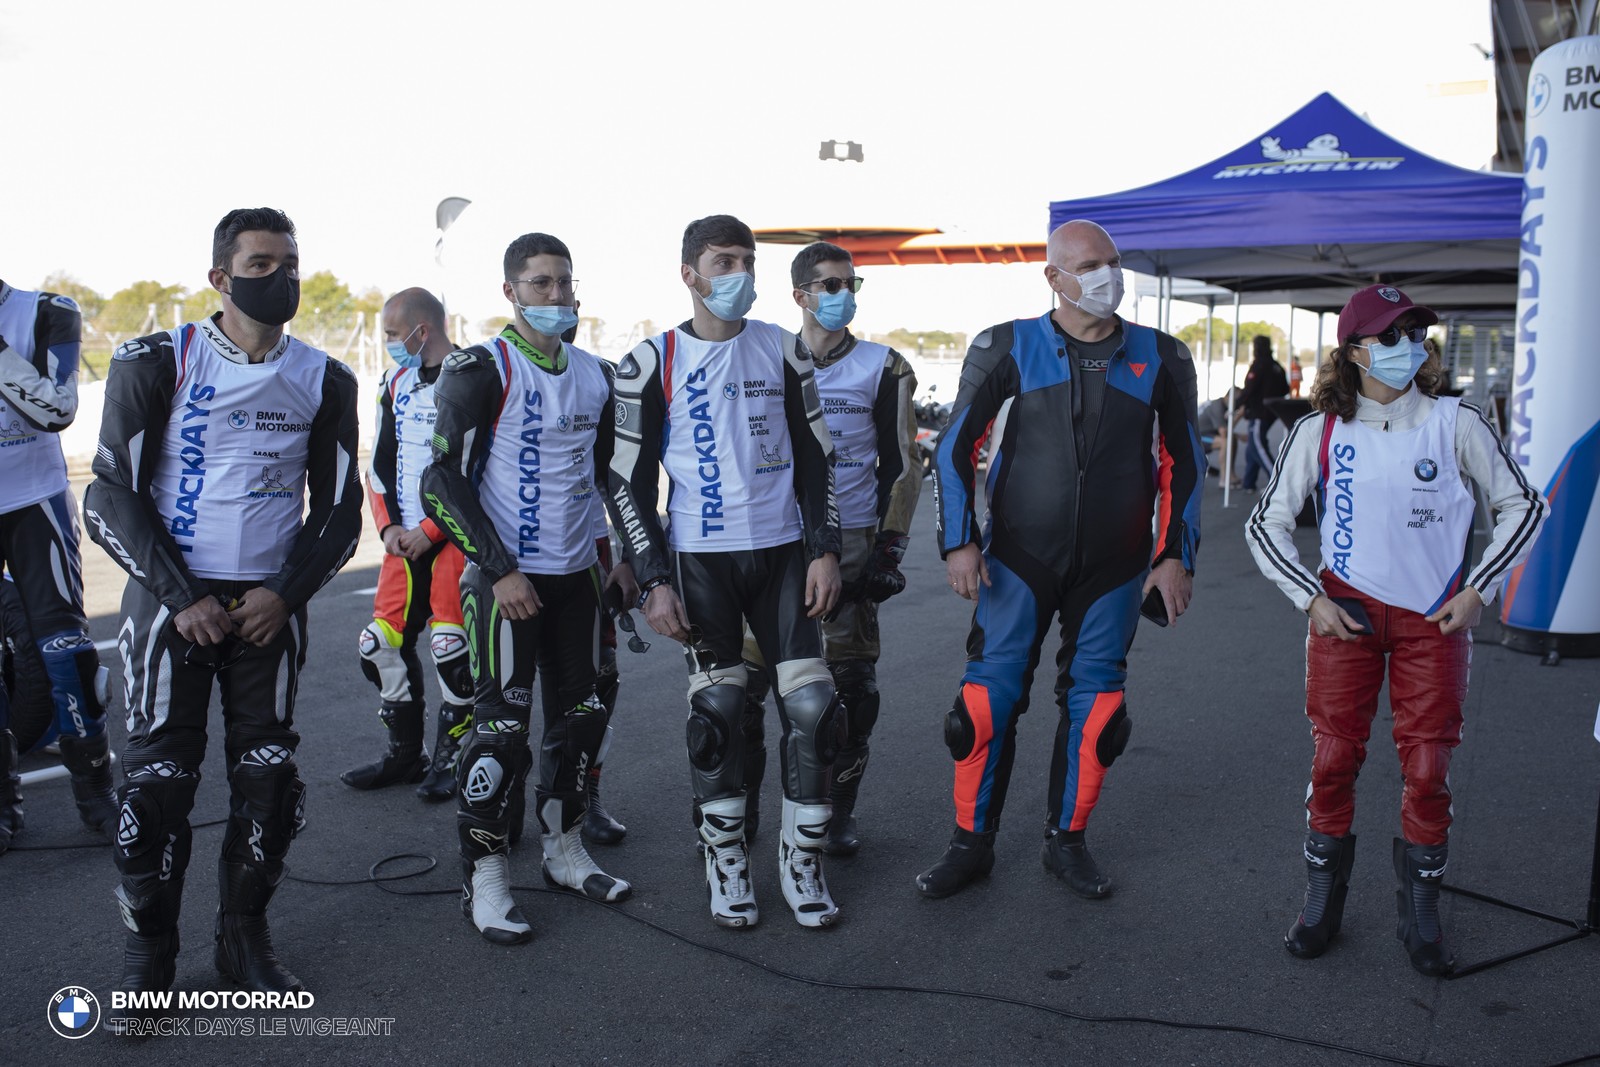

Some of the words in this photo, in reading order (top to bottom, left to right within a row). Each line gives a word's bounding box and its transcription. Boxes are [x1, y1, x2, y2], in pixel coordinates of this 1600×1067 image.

[1565, 65, 1600, 87] BM
[1213, 161, 1400, 179] MICHELIN
[1510, 135, 1548, 467] RACKDAYS
[744, 380, 766, 389] BMW
[745, 389, 784, 398] MOTORRA
[256, 411, 287, 421] BMW
[749, 415, 767, 423] MAKE
[0, 436, 37, 447] CHELIN
[253, 451, 280, 459] MAKE
[686, 367, 725, 538] TRACKDAYS
[519, 389, 543, 558] TRACKDAYS
[756, 463, 791, 475] MICHELIN
[1411, 508, 1435, 516] MAKE
[613, 484, 651, 555] YAMAHA
[1407, 521, 1427, 529] RIDE.
[1418, 861, 1448, 878] TC
